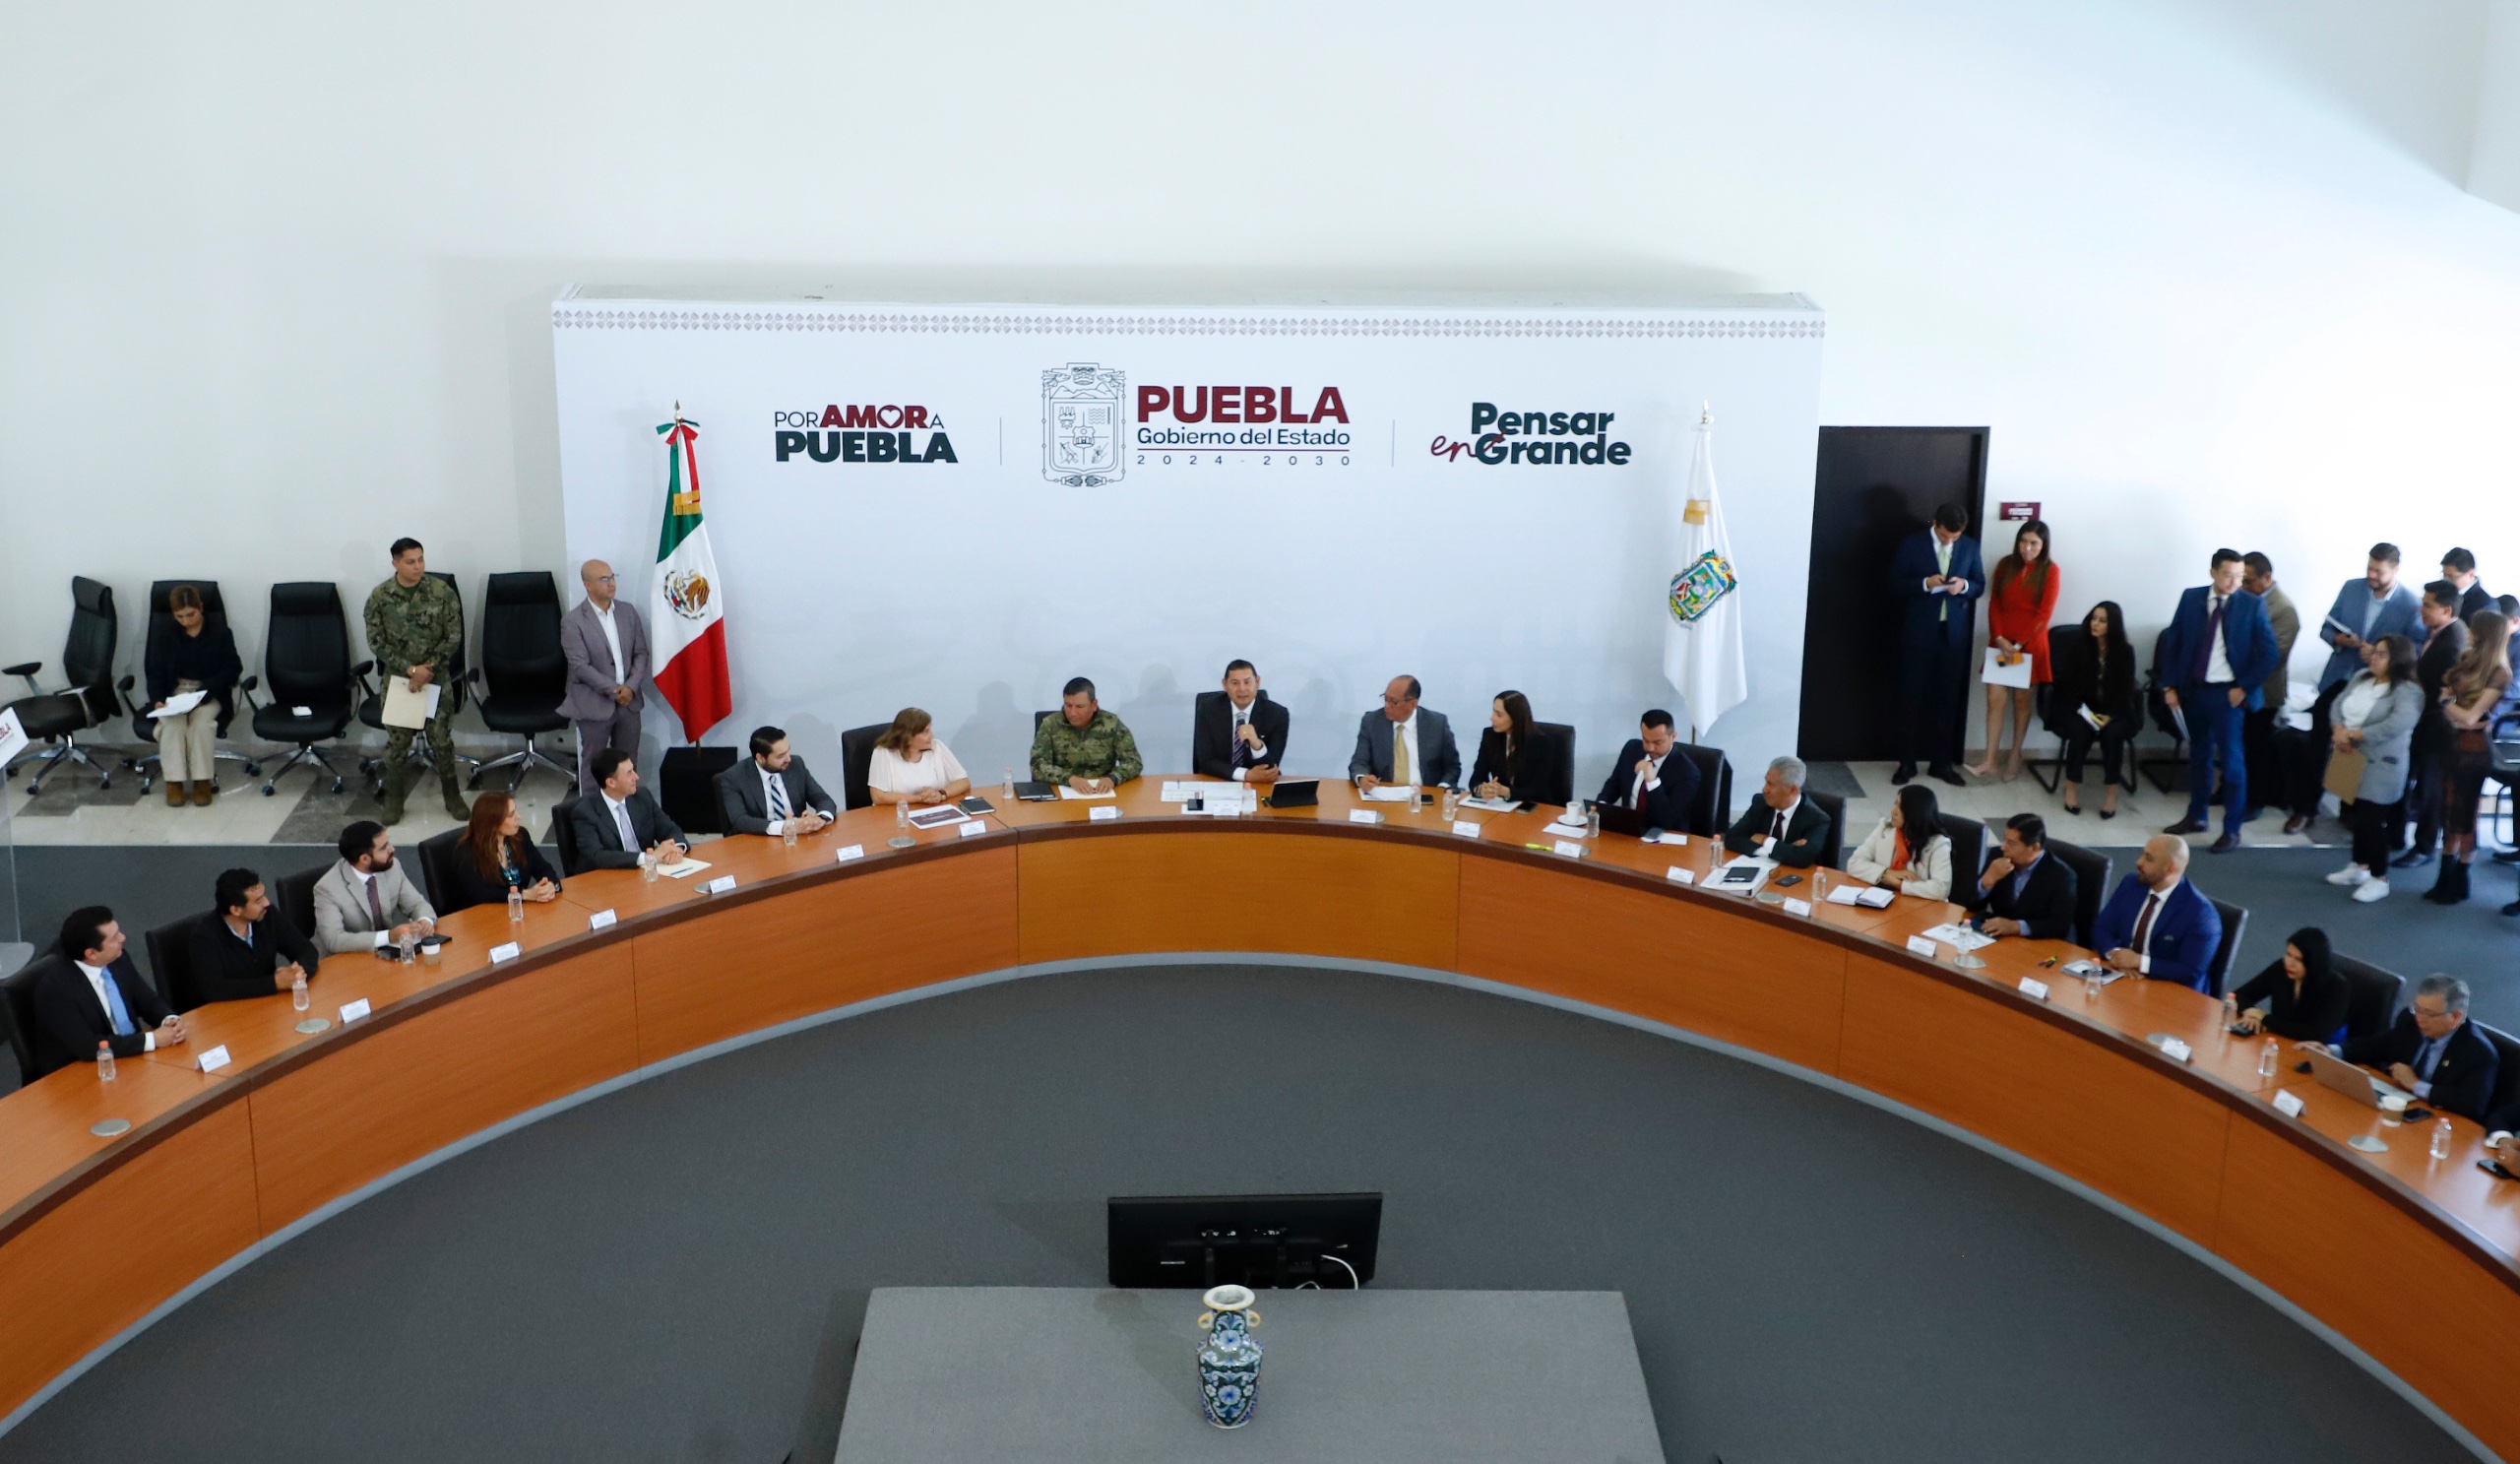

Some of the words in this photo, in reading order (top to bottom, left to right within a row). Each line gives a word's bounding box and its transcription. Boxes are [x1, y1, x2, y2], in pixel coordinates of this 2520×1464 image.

[775, 412, 819, 428] POR
[819, 405, 929, 429] AMOR
[929, 414, 945, 429] A
[1137, 385, 1351, 424] PUEBLA
[1471, 402, 1614, 435] Pensar
[776, 431, 959, 464] PUEBLA
[1137, 426, 1235, 445] Gobierno
[1240, 428, 1272, 445] del
[1278, 428, 1351, 445] Estado
[1430, 434, 1482, 463] en
[1476, 432, 1632, 466] Grande
